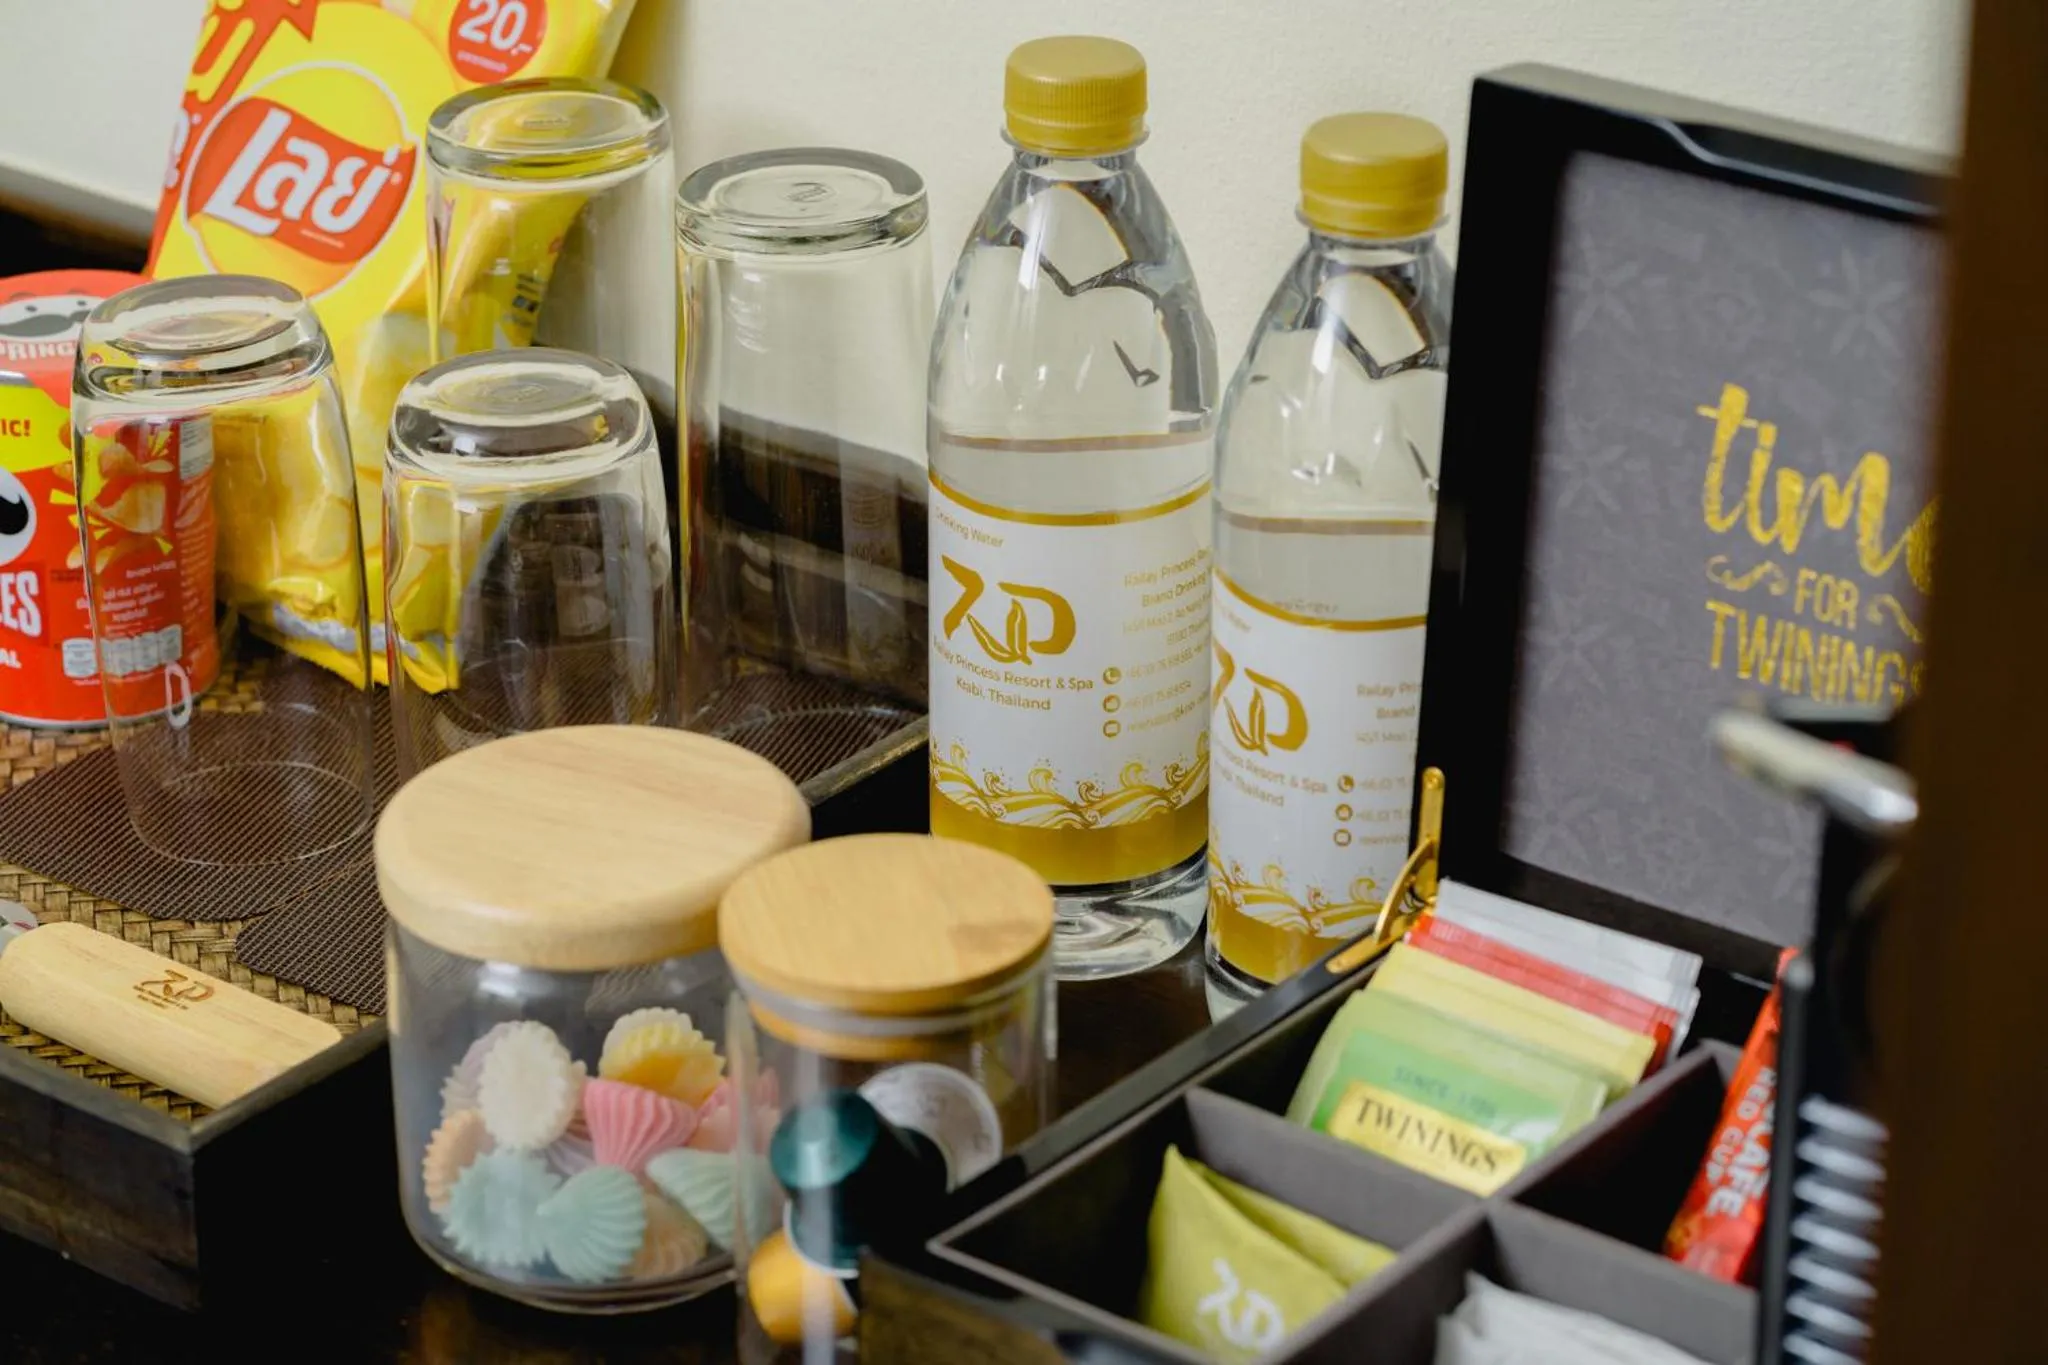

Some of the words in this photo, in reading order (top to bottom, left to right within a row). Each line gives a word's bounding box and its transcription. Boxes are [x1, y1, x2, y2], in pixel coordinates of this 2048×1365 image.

[0, 570, 42, 637] ES
[1794, 568, 1859, 630] FOR
[955, 653, 1001, 683] Princess
[1003, 670, 1051, 690] Resort
[1055, 677, 1066, 690] &
[1068, 677, 1094, 693] Spa
[987, 688, 1052, 711] Thailand
[1356, 1096, 1497, 1176] TWININGS
